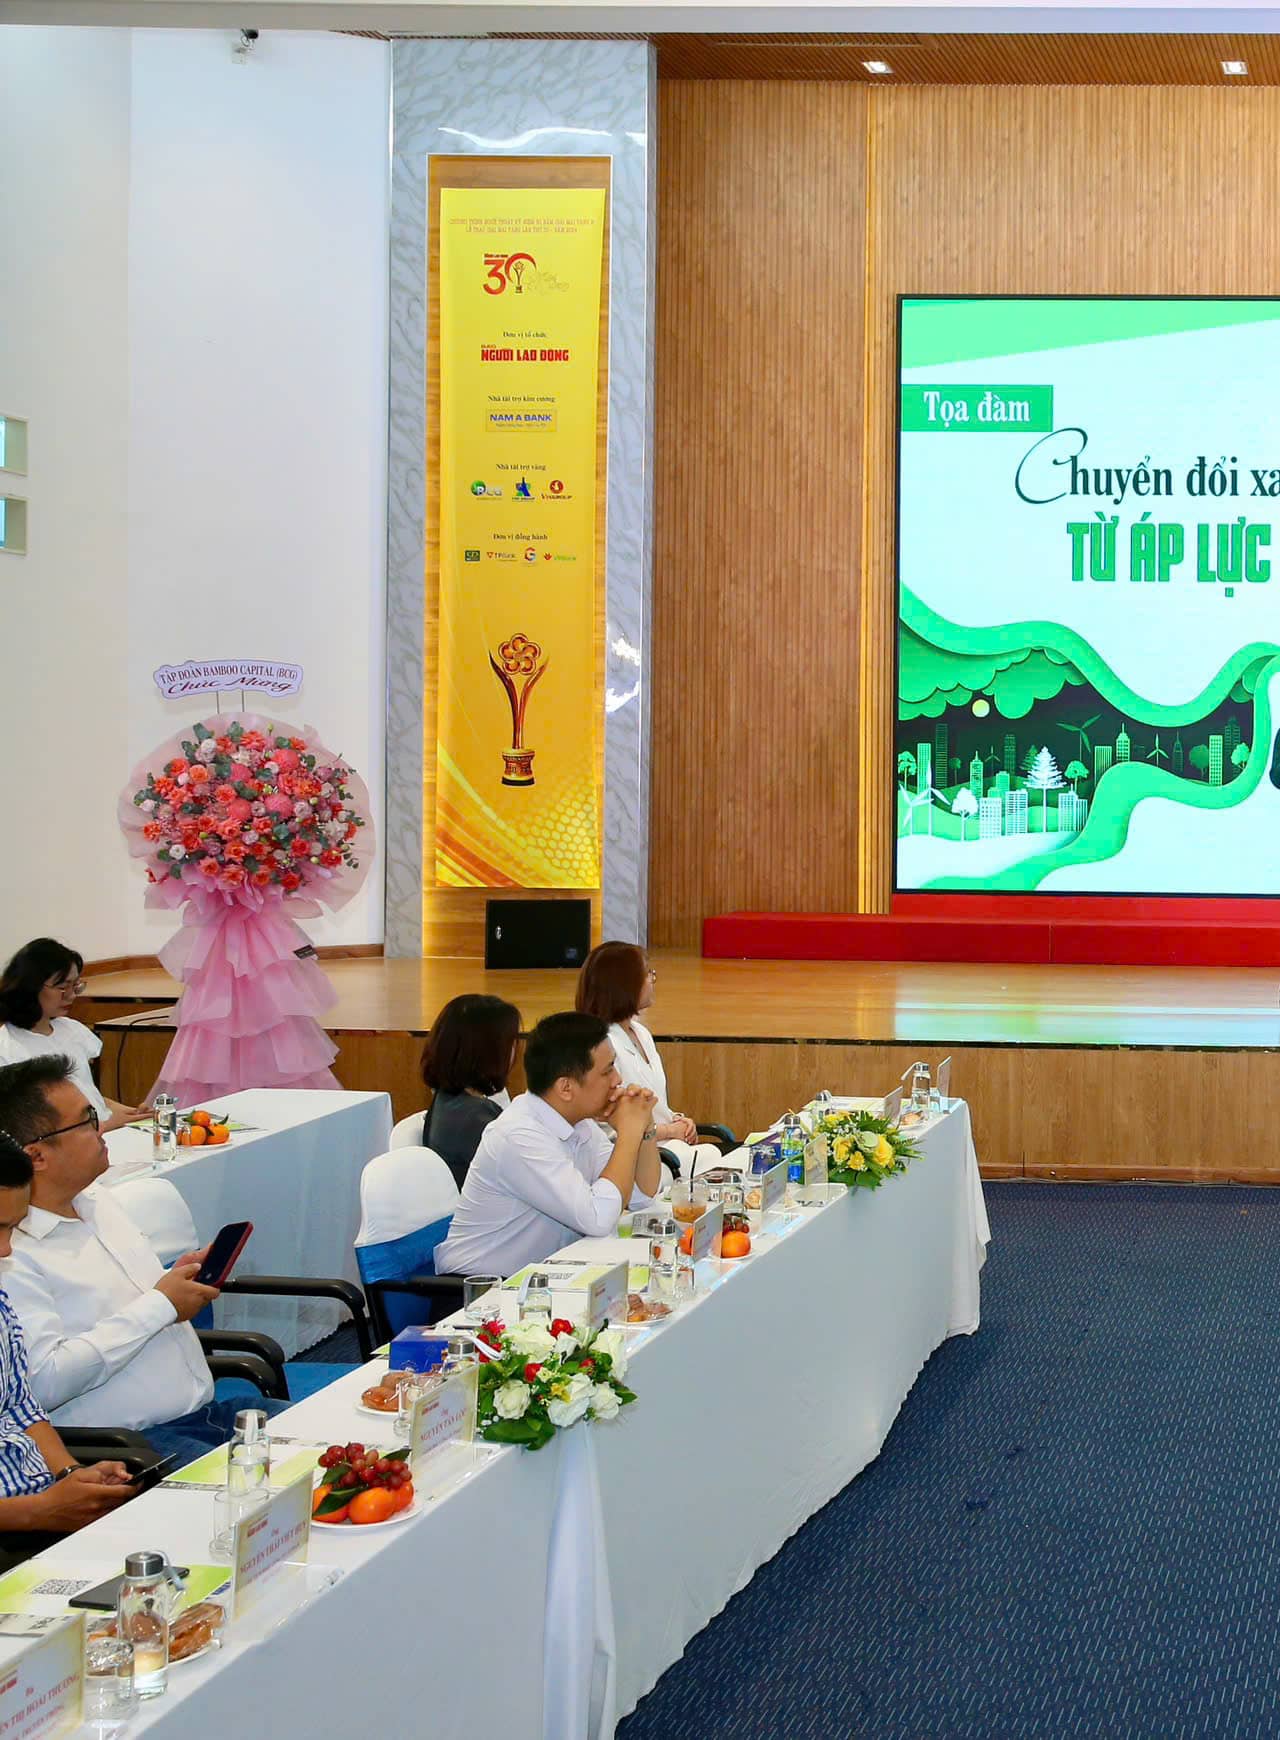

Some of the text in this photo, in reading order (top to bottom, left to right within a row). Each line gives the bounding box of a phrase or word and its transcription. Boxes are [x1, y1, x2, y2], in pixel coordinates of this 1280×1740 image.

[516, 349, 537, 362] LAO
[924, 390, 1031, 428] Tọa đàm
[1014, 427, 1173, 505] Chuyển
[1186, 455, 1240, 498] đổi
[1066, 510, 1120, 582] TỪ
[1130, 511, 1184, 582] ÁP
[1196, 516, 1272, 598] LỰC
[203, 665, 238, 677] BAMBOO
[240, 664, 274, 677] CAPITAL
